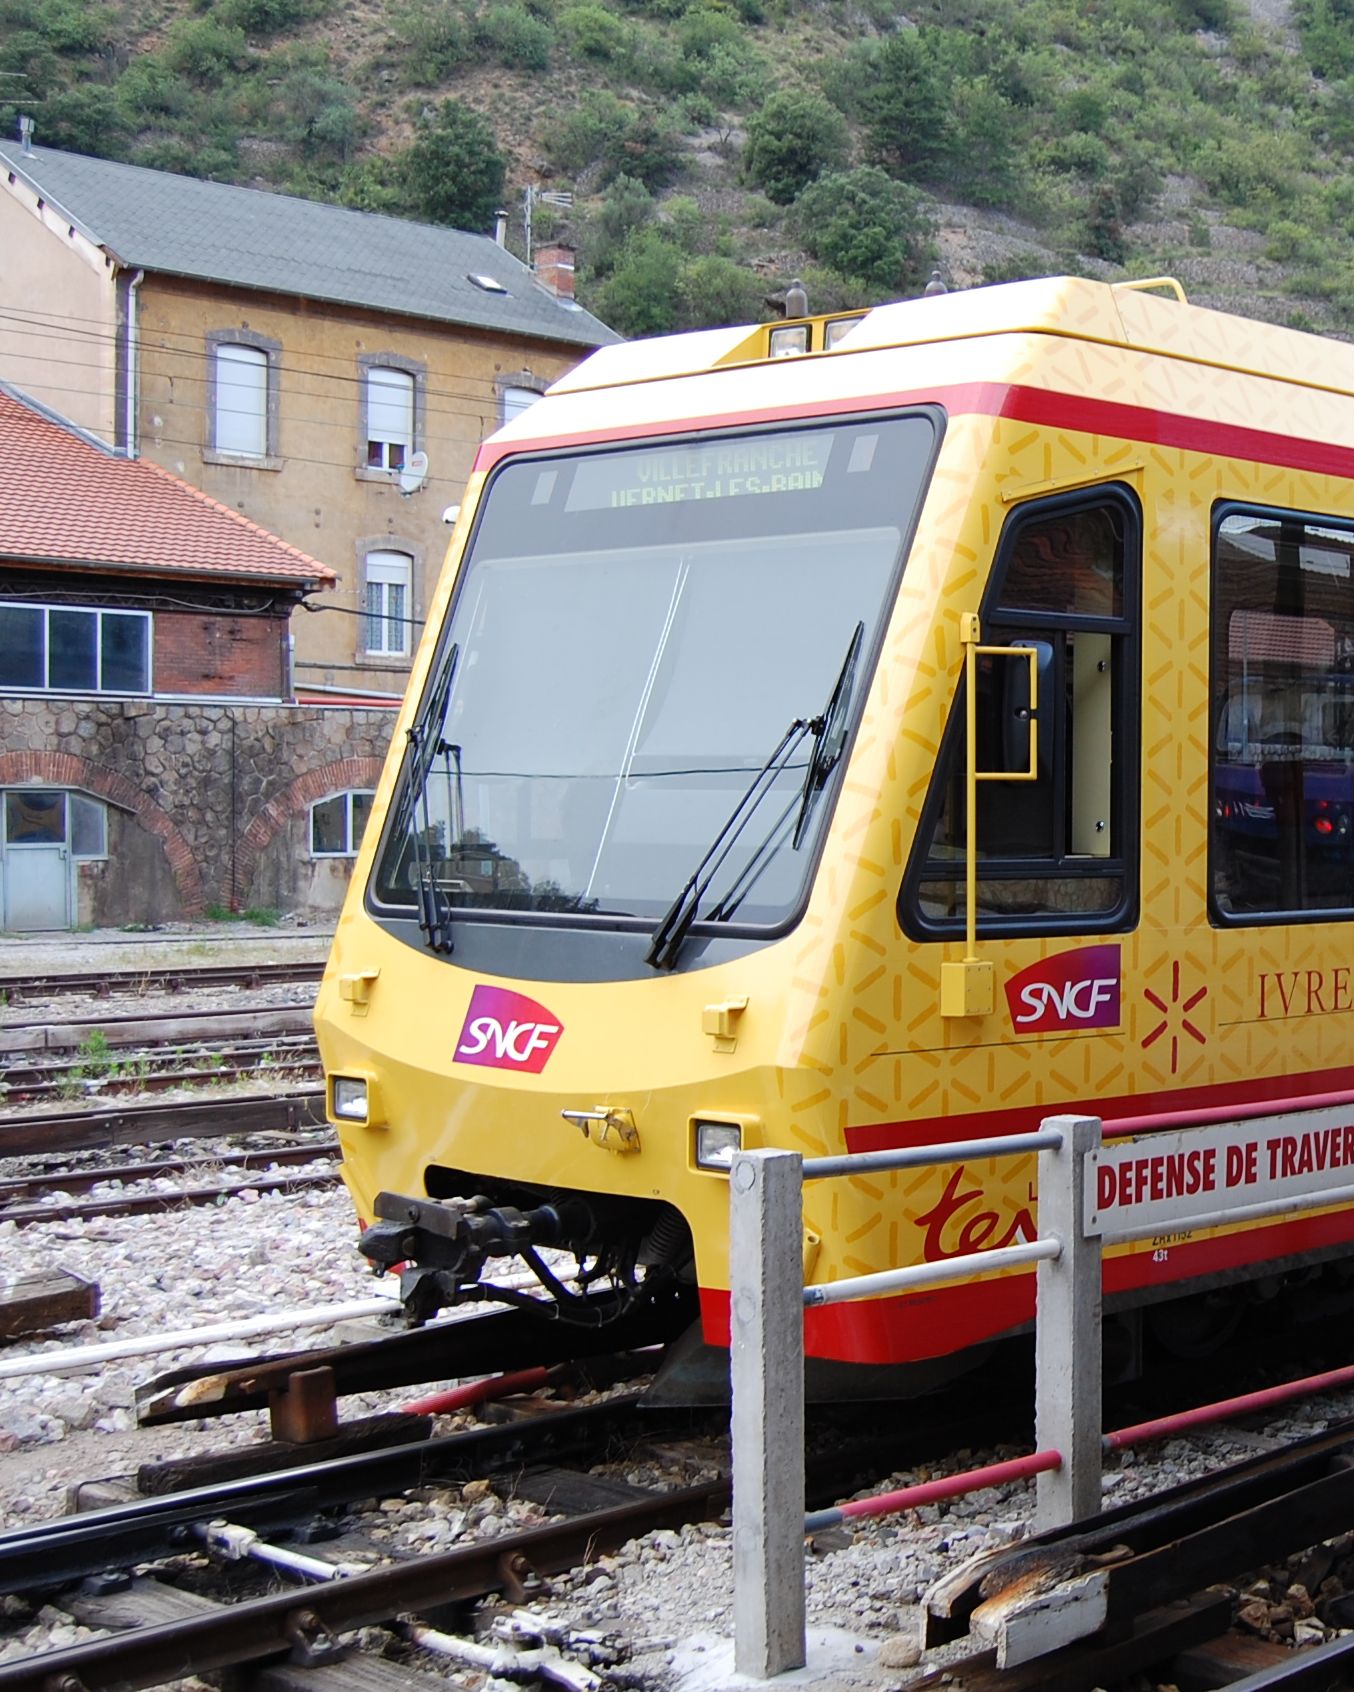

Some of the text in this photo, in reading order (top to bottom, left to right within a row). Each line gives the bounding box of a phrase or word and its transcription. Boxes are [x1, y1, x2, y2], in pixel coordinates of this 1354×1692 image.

[637, 441, 819, 482] VILLEFRANCHE
[1016, 978, 1118, 1023] SNCF
[1257, 967, 1353, 1018] IVRE
[459, 1017, 560, 1062] SNCF
[1097, 1149, 1216, 1210] DEFENSE
[1225, 1141, 1258, 1188] DE
